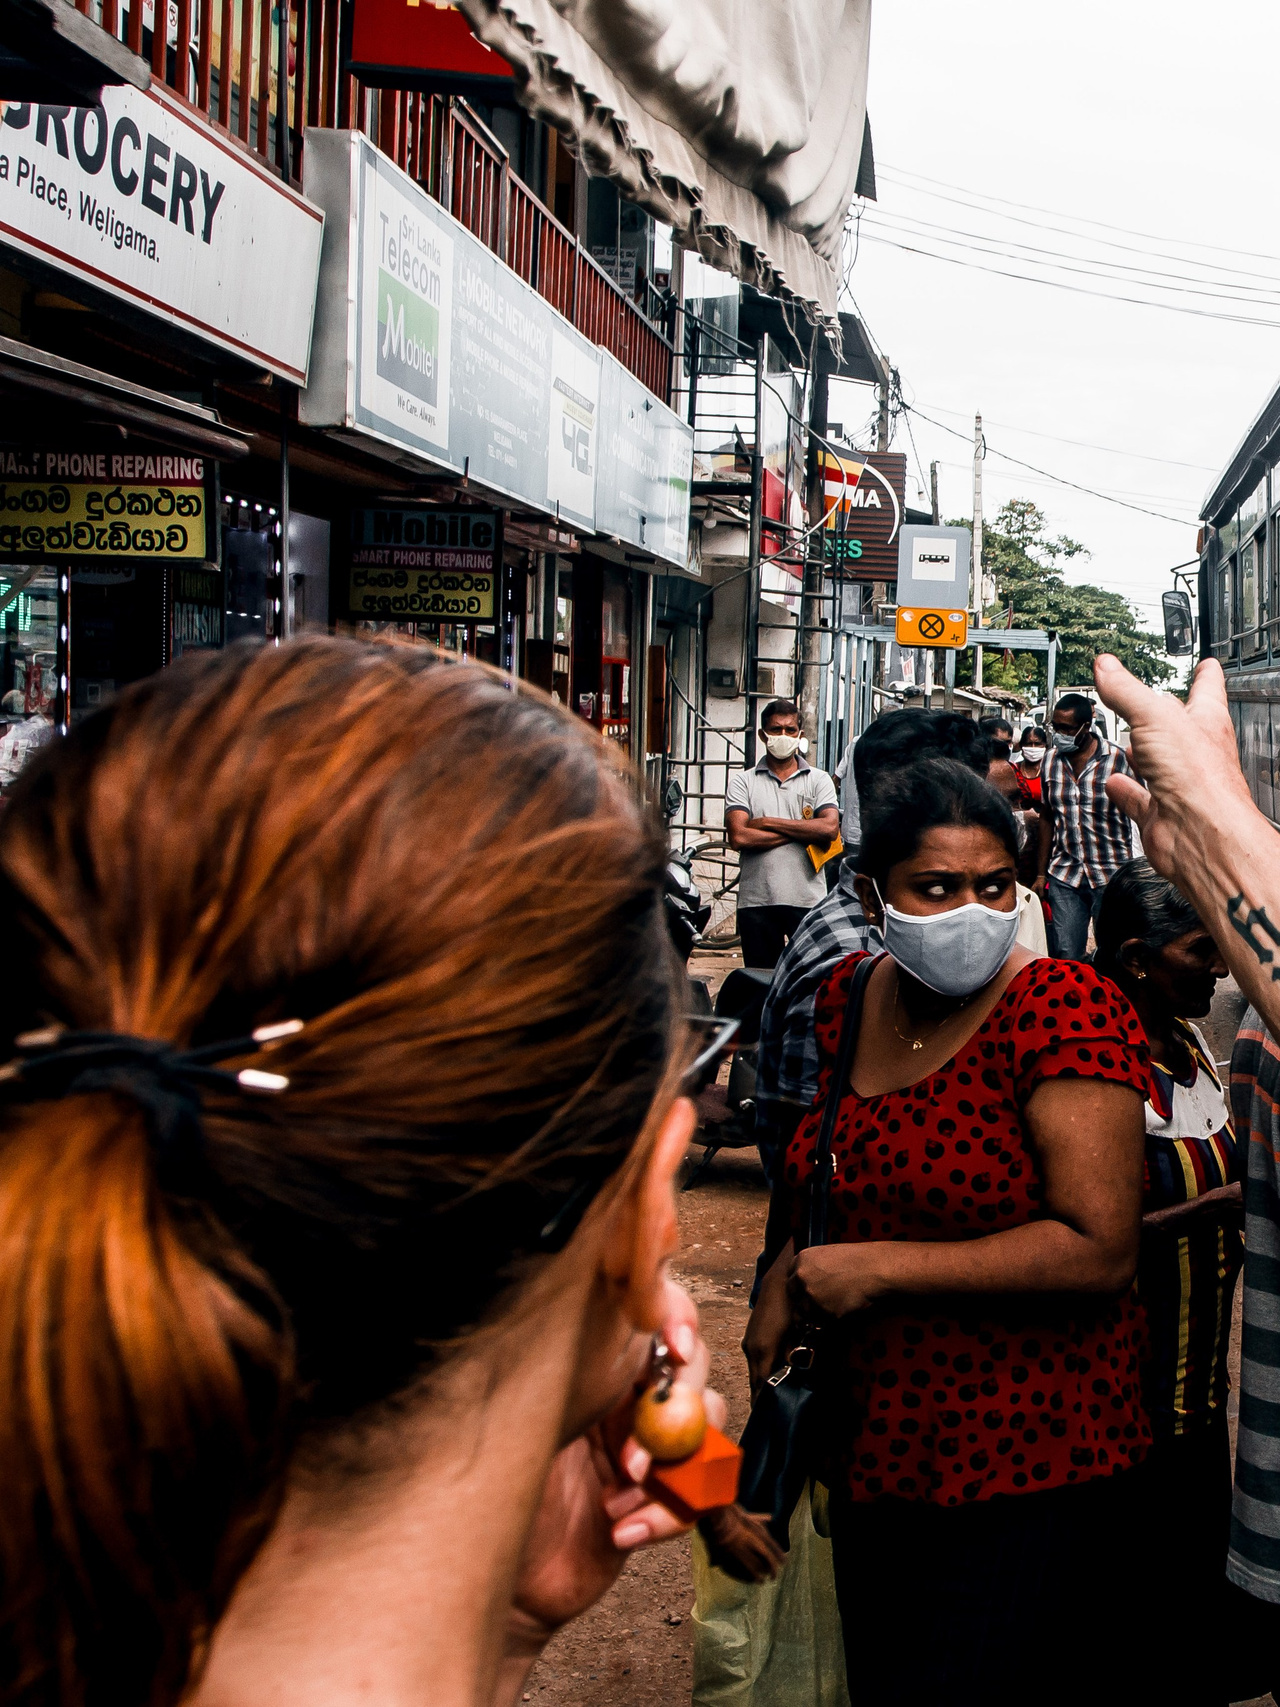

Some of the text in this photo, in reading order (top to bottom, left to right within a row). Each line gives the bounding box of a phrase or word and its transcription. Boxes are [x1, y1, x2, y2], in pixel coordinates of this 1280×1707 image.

[16, 155, 73, 221] Place,
[79, 190, 160, 263] Weligama.
[379, 210, 441, 306] Telecom
[402, 214, 441, 267] Sri Lanka
[382, 293, 435, 380] Mobitel
[505, 298, 547, 362] NETWORK
[397, 393, 405, 411] We
[405, 398, 418, 417] Care.
[46, 454, 106, 478] PHONE
[112, 455, 204, 480] REPAIRING
[374, 511, 493, 548] Mobile
[353, 549, 493, 570] SMART PHONE REPAIRING
